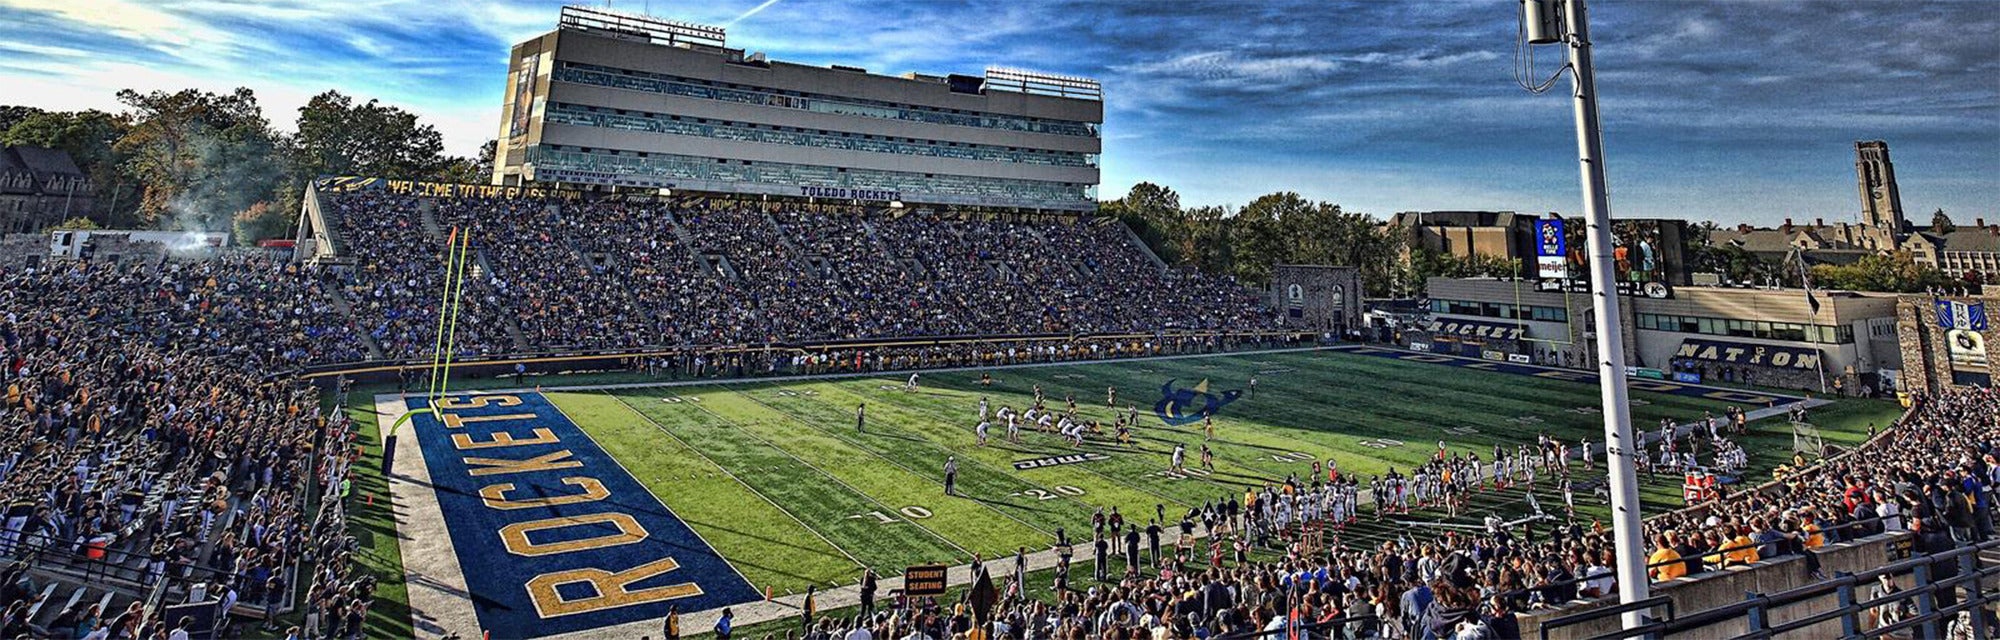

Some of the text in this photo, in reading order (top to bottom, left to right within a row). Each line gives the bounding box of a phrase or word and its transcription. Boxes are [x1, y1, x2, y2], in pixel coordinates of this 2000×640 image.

[387, 180, 454, 197] WELCOME
[458, 184, 475, 198] TO
[800, 186, 902, 201] TOLEDO ROCKETS
[1427, 321, 1526, 340] ROCKET
[1023, 485, 1086, 501] 20
[434, 394, 704, 619] ROCKETS
[865, 505, 934, 526] 10
[908, 570, 945, 580] STUDENT
[908, 581, 943, 590] SEATING
